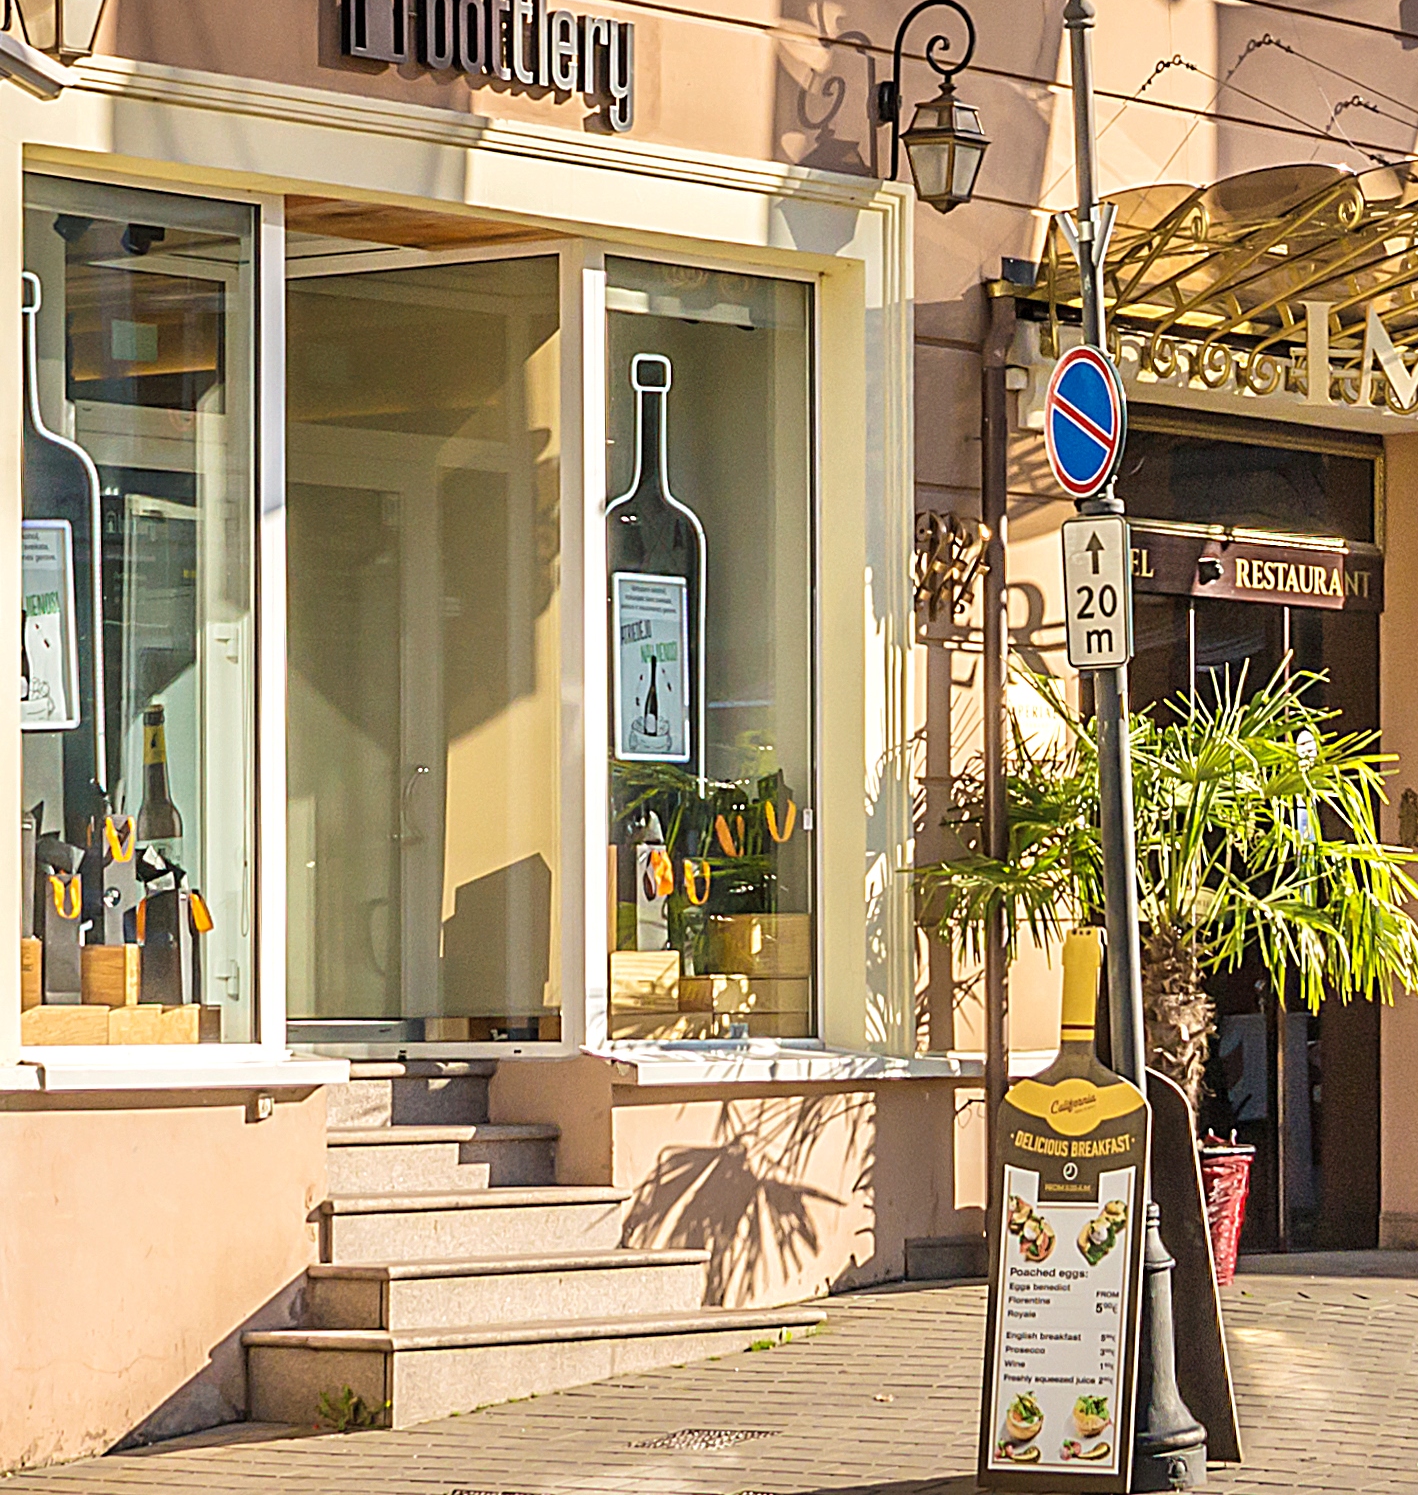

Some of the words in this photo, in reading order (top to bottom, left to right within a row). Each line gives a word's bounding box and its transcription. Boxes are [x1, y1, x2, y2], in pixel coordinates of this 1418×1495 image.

[1235, 557, 1371, 598] RESTAURANT
[1076, 585, 1118, 619] 20
[1086, 628, 1113, 654] m
[1050, 1094, 1096, 1114] California
[1014, 1130, 1069, 1157] DELICIOUS
[1071, 1133, 1131, 1158] BREAKFAST
[1009, 1267, 1056, 1278] Poached
[1058, 1270, 1089, 1280] eggs:
[1008, 1282, 1031, 1291] Eggs
[1033, 1283, 1071, 1292] benedict
[1008, 1296, 1051, 1305] Florentine
[1007, 1310, 1036, 1319] Royale
[1006, 1332, 1037, 1341] English
[1039, 1332, 1081, 1341] breakfast
[1005, 1346, 1045, 1355] Prosecco
[1004, 1360, 1026, 1368] Wine
[1003, 1374, 1032, 1384] Freshly
[1034, 1376, 1074, 1384] squeezed
[1075, 1376, 1096, 1386] juice
